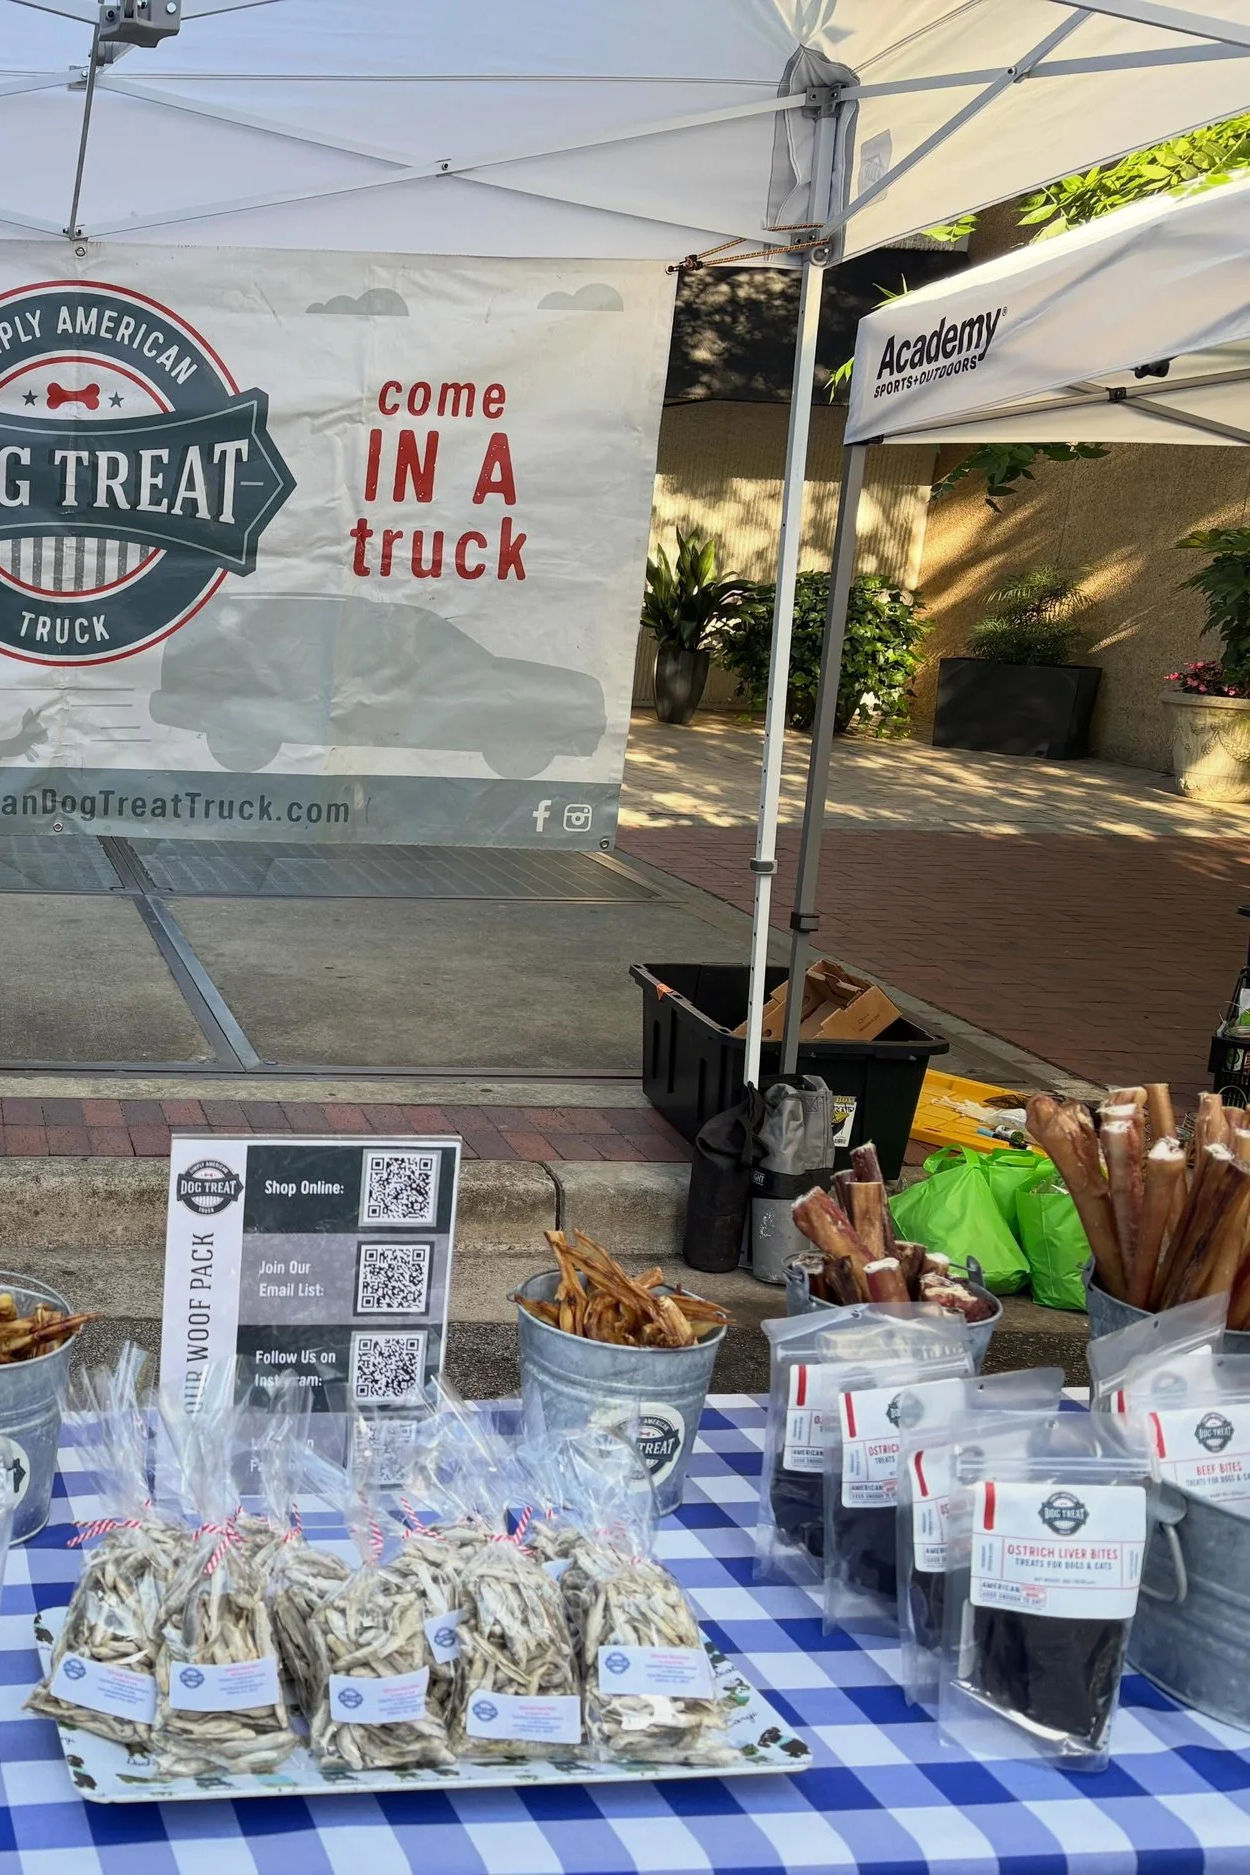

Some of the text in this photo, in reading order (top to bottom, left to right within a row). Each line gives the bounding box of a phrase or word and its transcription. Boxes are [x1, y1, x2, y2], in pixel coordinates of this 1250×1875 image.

[56, 306, 198, 385] AMERICAN
[876, 307, 1002, 380] Academy
[874, 354, 977, 399] SPORTS+OUTDOORS
[378, 380, 506, 419] come
[364, 428, 517, 505] IN A
[54, 438, 249, 525] TREAT
[350, 516, 527, 581] truck
[20, 611, 110, 644] TRUCK
[180, 1179, 237, 1195] DOG TREAT
[264, 1180, 345, 1197] Shop Online:
[190, 1232, 215, 1290] PACK
[259, 1260, 311, 1274] Join Our
[259, 1283, 325, 1297] Email List:
[187, 1298, 211, 1363] WOOF
[255, 1350, 336, 1364] Follow Us on
[255, 1373, 323, 1387] Instam:
[638, 1437, 676, 1455] TREAT
[1196, 1461, 1243, 1476] BEEF BITES
[1007, 1544, 1055, 1559] OSTRICH
[1058, 1547, 1087, 1560] LIVER
[1090, 1547, 1118, 1560] BITES
[1015, 1557, 1044, 1568] TREATS
[1047, 1559, 1063, 1569] FOR
